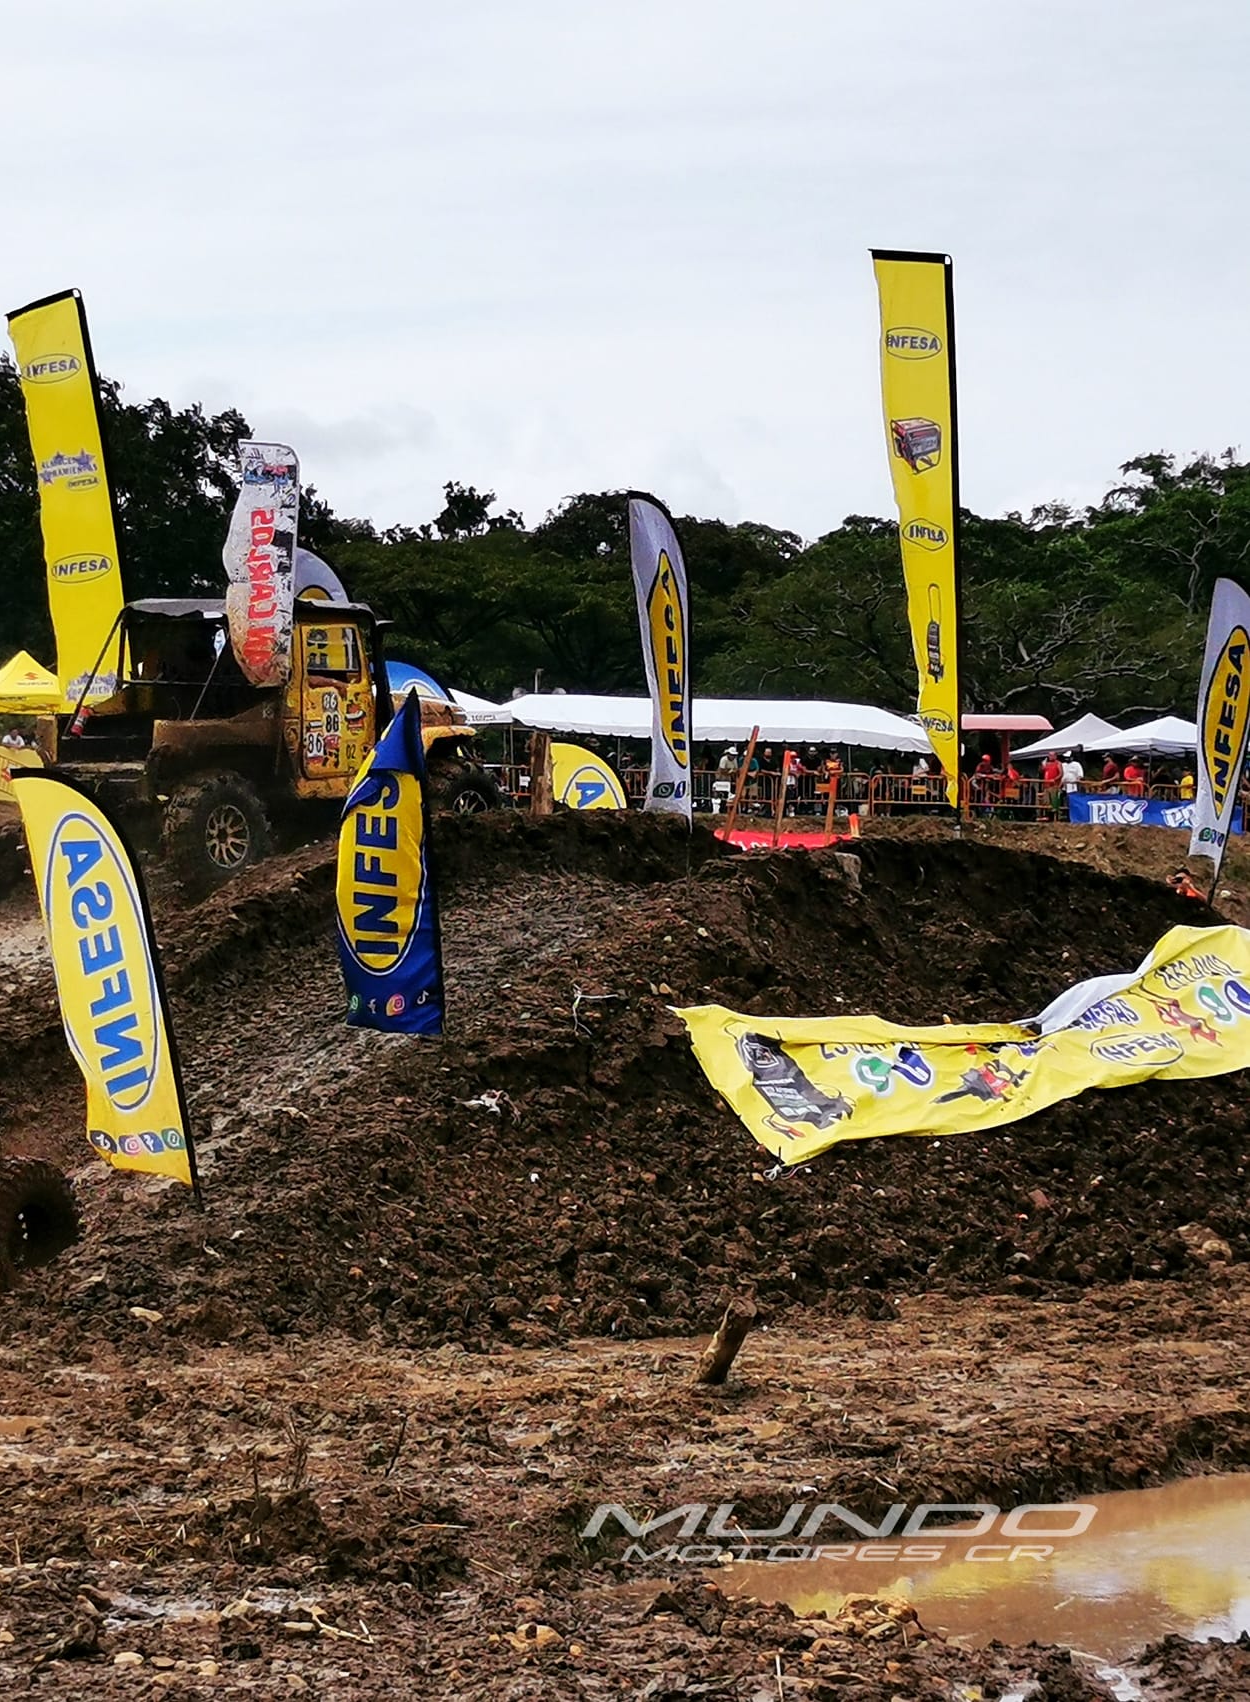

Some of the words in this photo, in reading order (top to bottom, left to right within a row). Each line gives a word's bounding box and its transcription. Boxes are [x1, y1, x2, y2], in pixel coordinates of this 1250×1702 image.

[887, 335, 938, 350] INFESA
[53, 559, 109, 577] INFESA
[307, 733, 323, 754] 86
